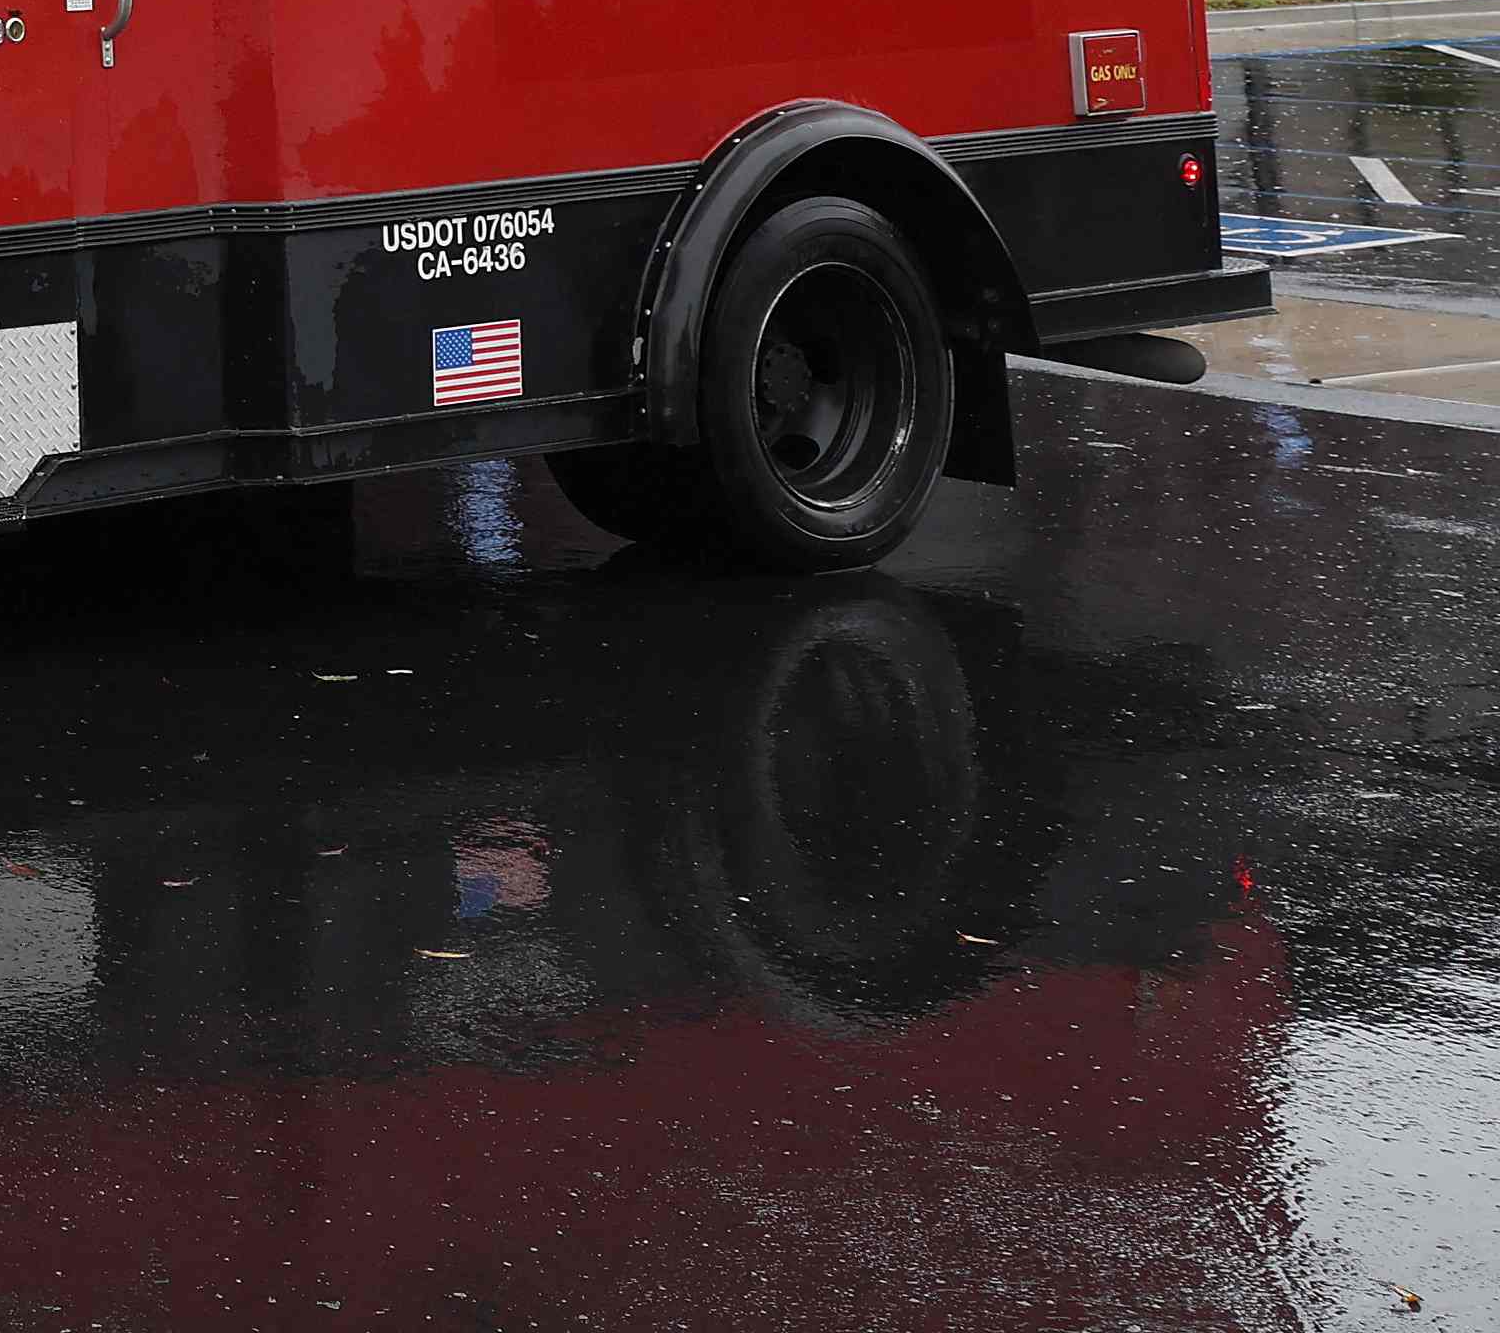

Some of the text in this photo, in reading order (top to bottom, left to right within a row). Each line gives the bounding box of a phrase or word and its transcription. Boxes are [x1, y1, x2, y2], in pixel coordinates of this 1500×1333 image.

[1090, 63, 1137, 82] GAS ONLY
[382, 207, 555, 252] USDOT 076054
[417, 241, 526, 281] CA-6436
